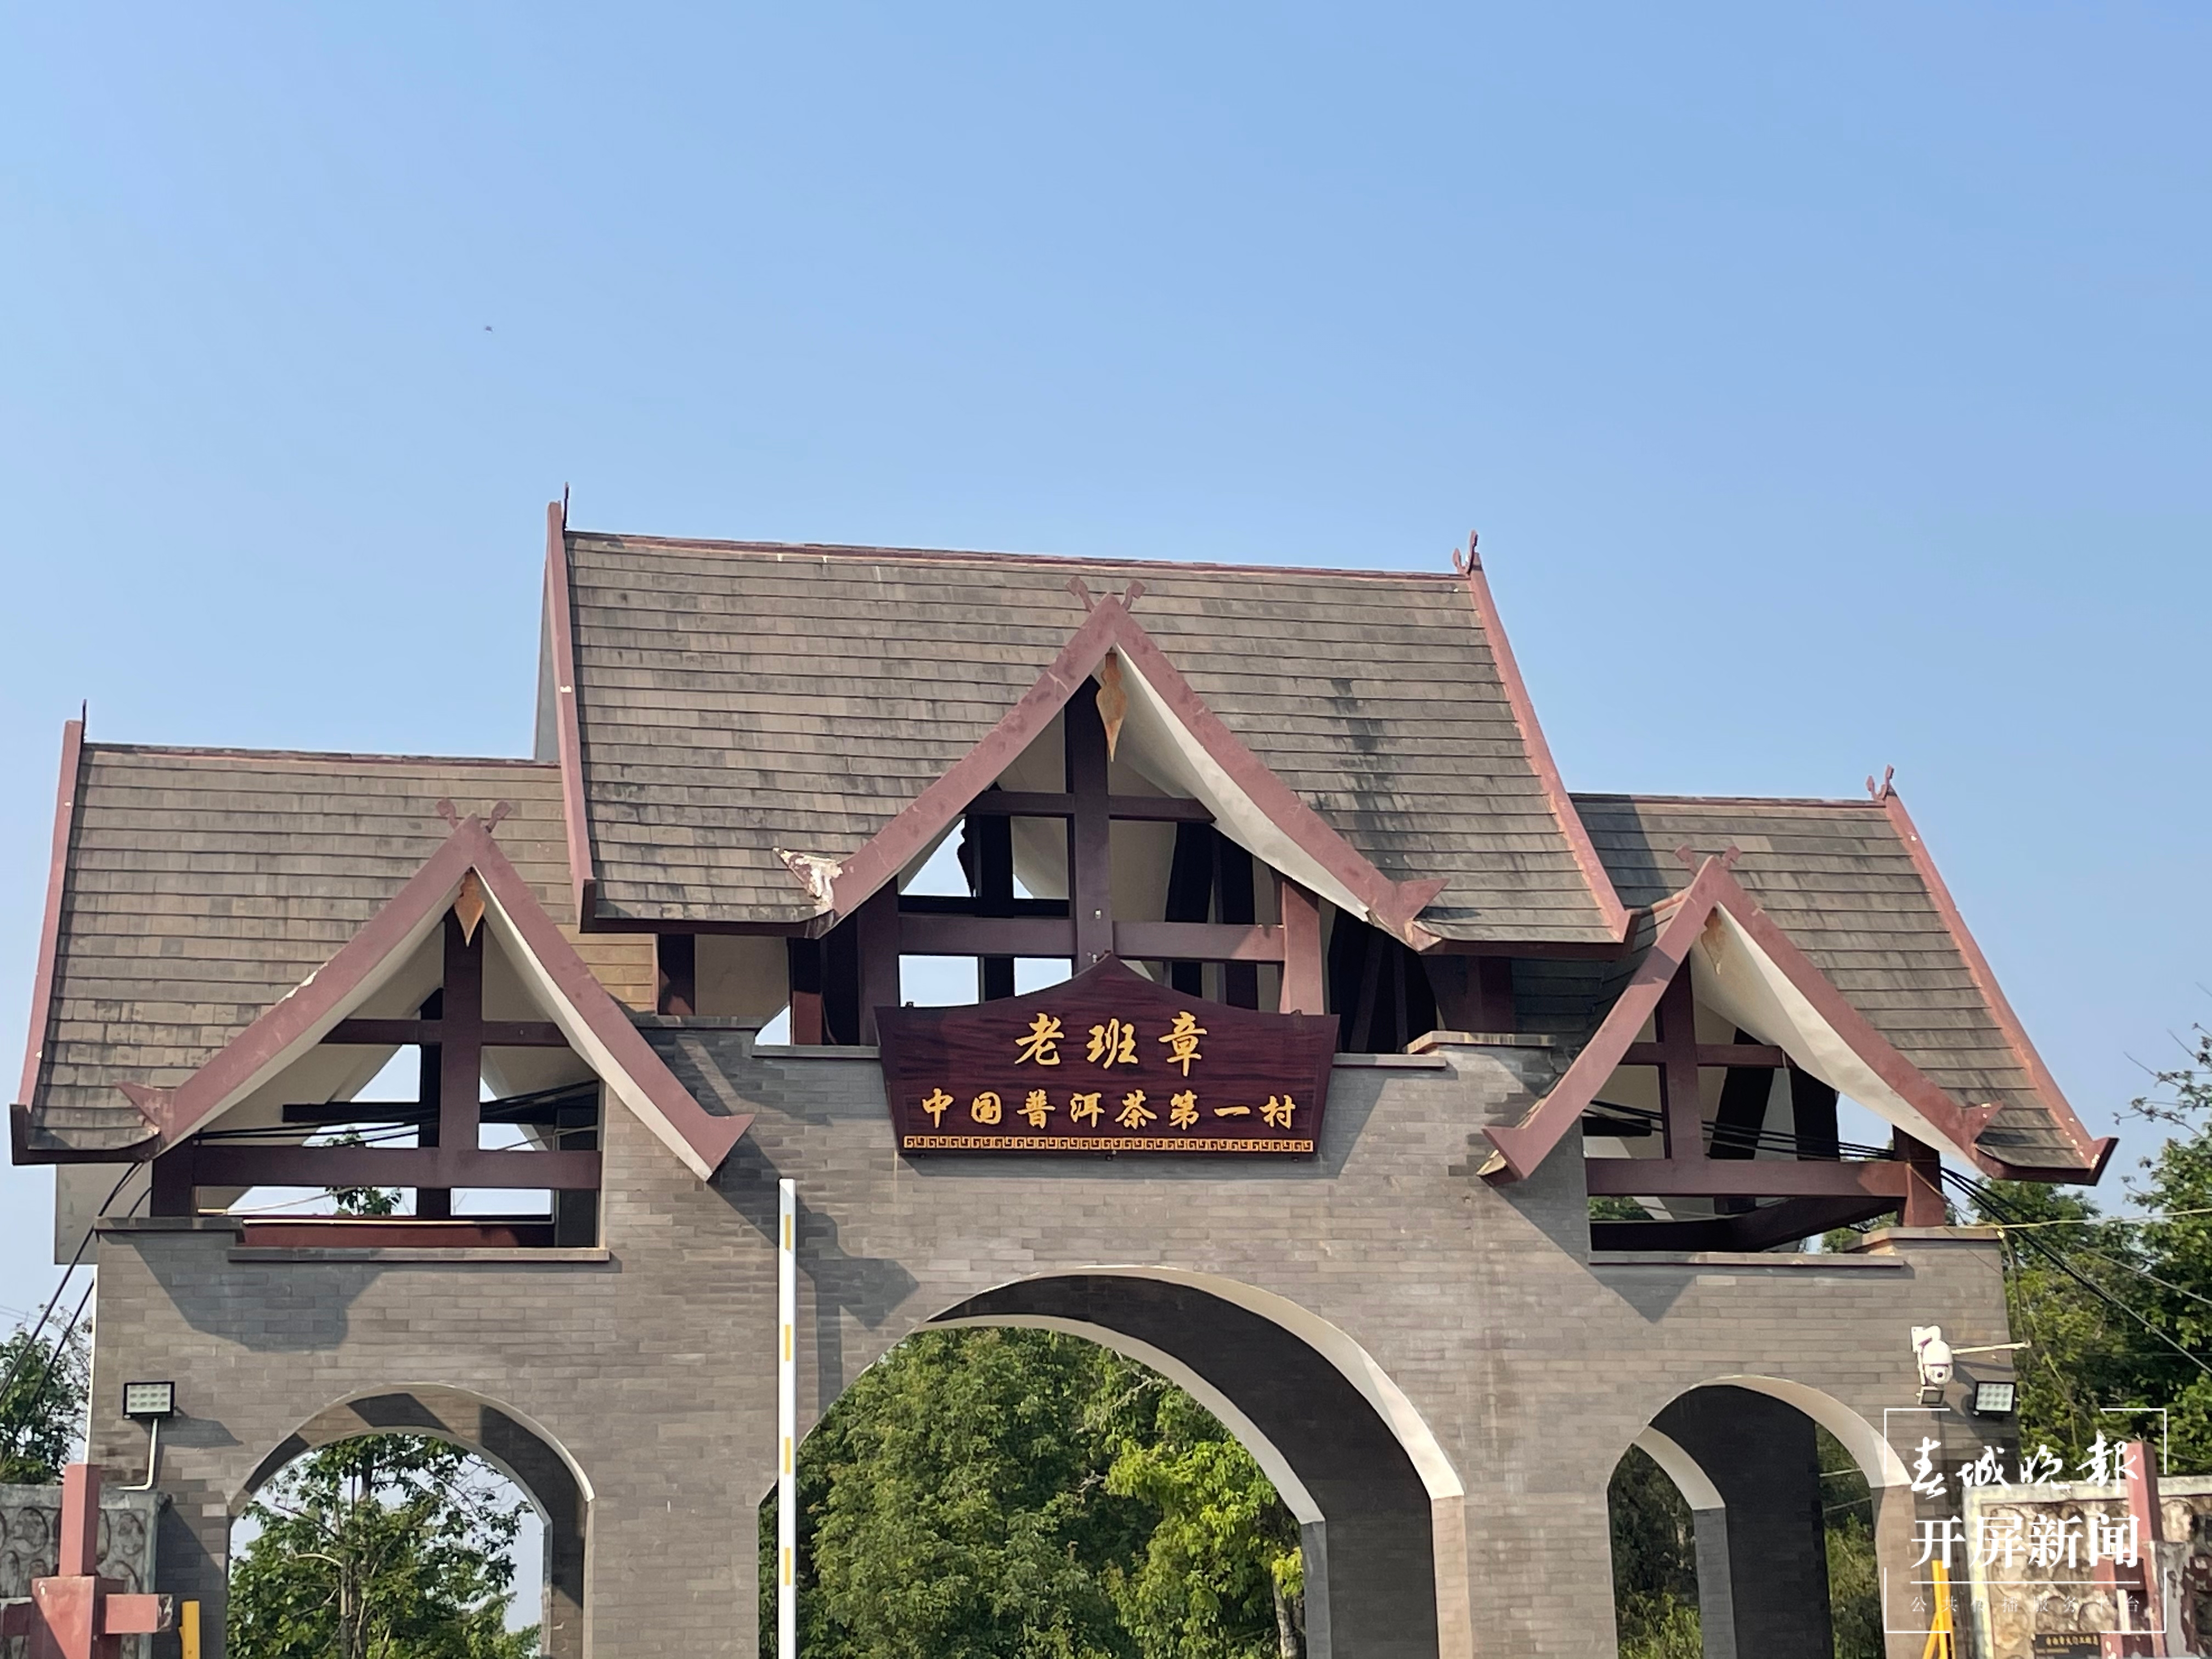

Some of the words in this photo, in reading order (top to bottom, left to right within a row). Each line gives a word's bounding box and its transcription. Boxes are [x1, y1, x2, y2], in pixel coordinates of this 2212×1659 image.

[1015, 1011, 1208, 1076] 老班章
[922, 1088, 1296, 1130] 中国普洱茶第一村
